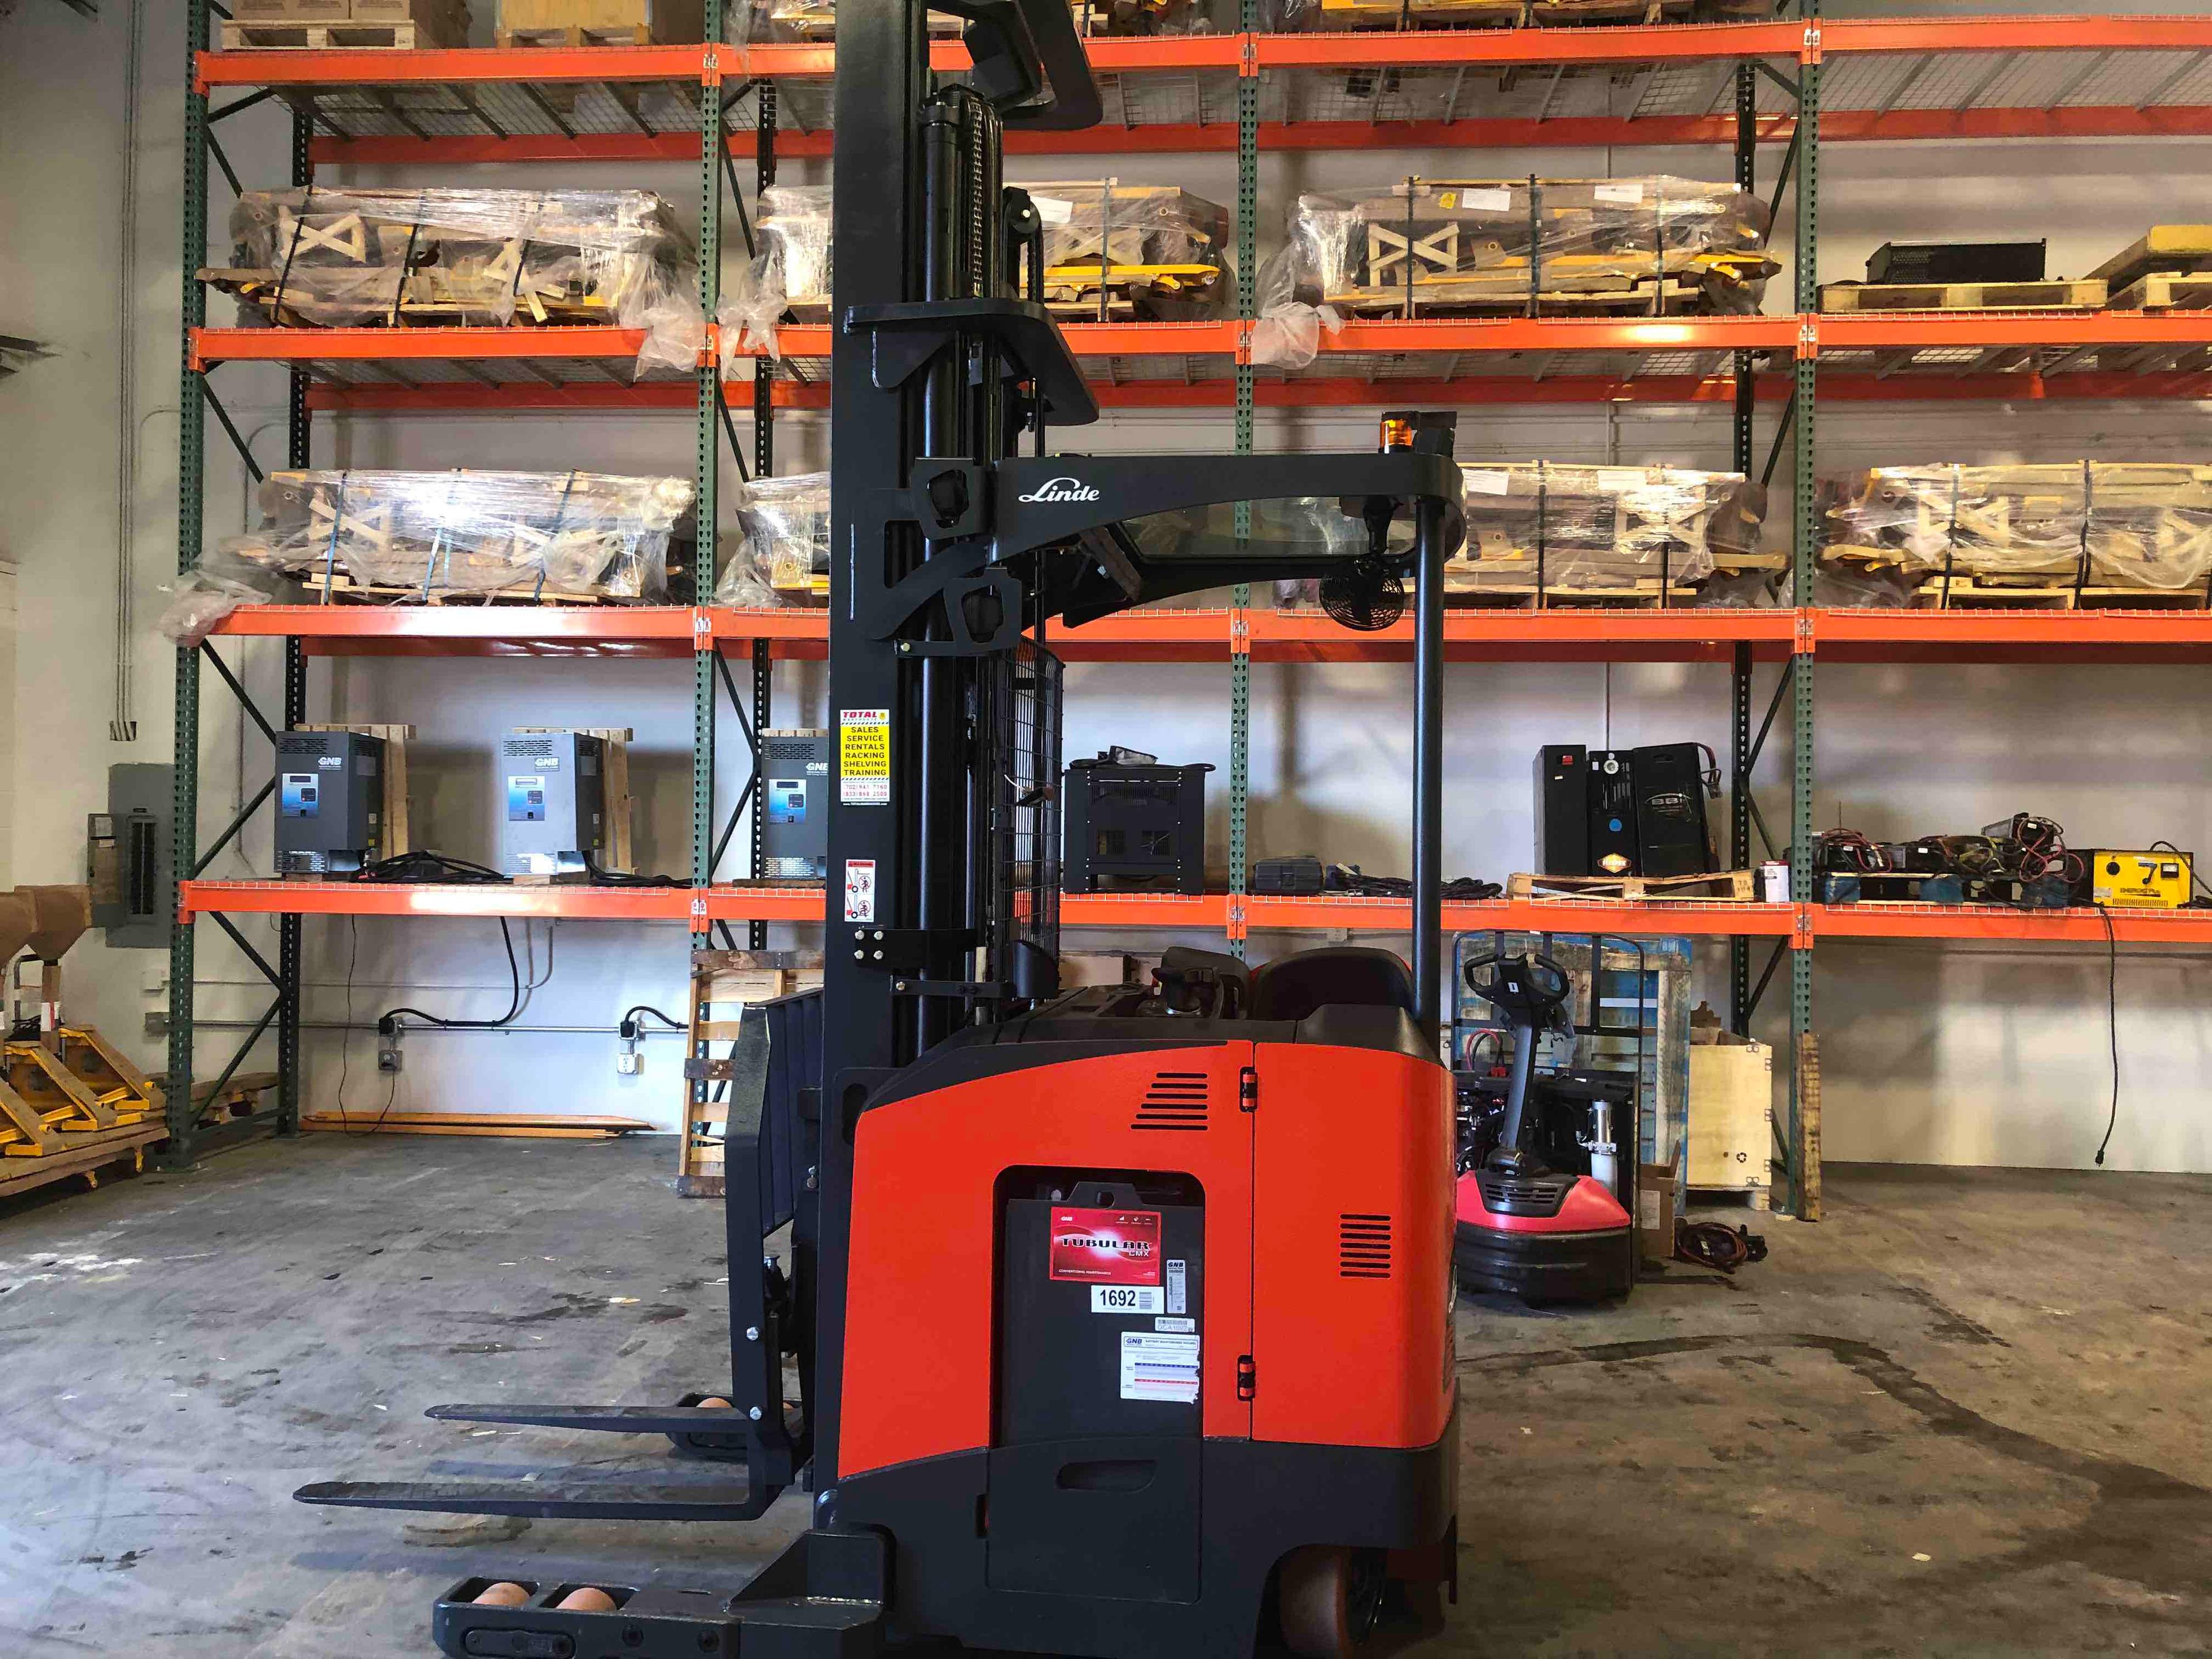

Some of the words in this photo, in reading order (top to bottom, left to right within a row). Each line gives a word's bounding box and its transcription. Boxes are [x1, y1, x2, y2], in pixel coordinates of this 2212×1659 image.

[1018, 477, 1100, 502] Linde
[318, 757, 342, 765] GNB
[535, 757, 559, 766] GNB
[1062, 1238, 1150, 1251] TUBULAR
[1100, 1289, 1136, 1306] 1692
